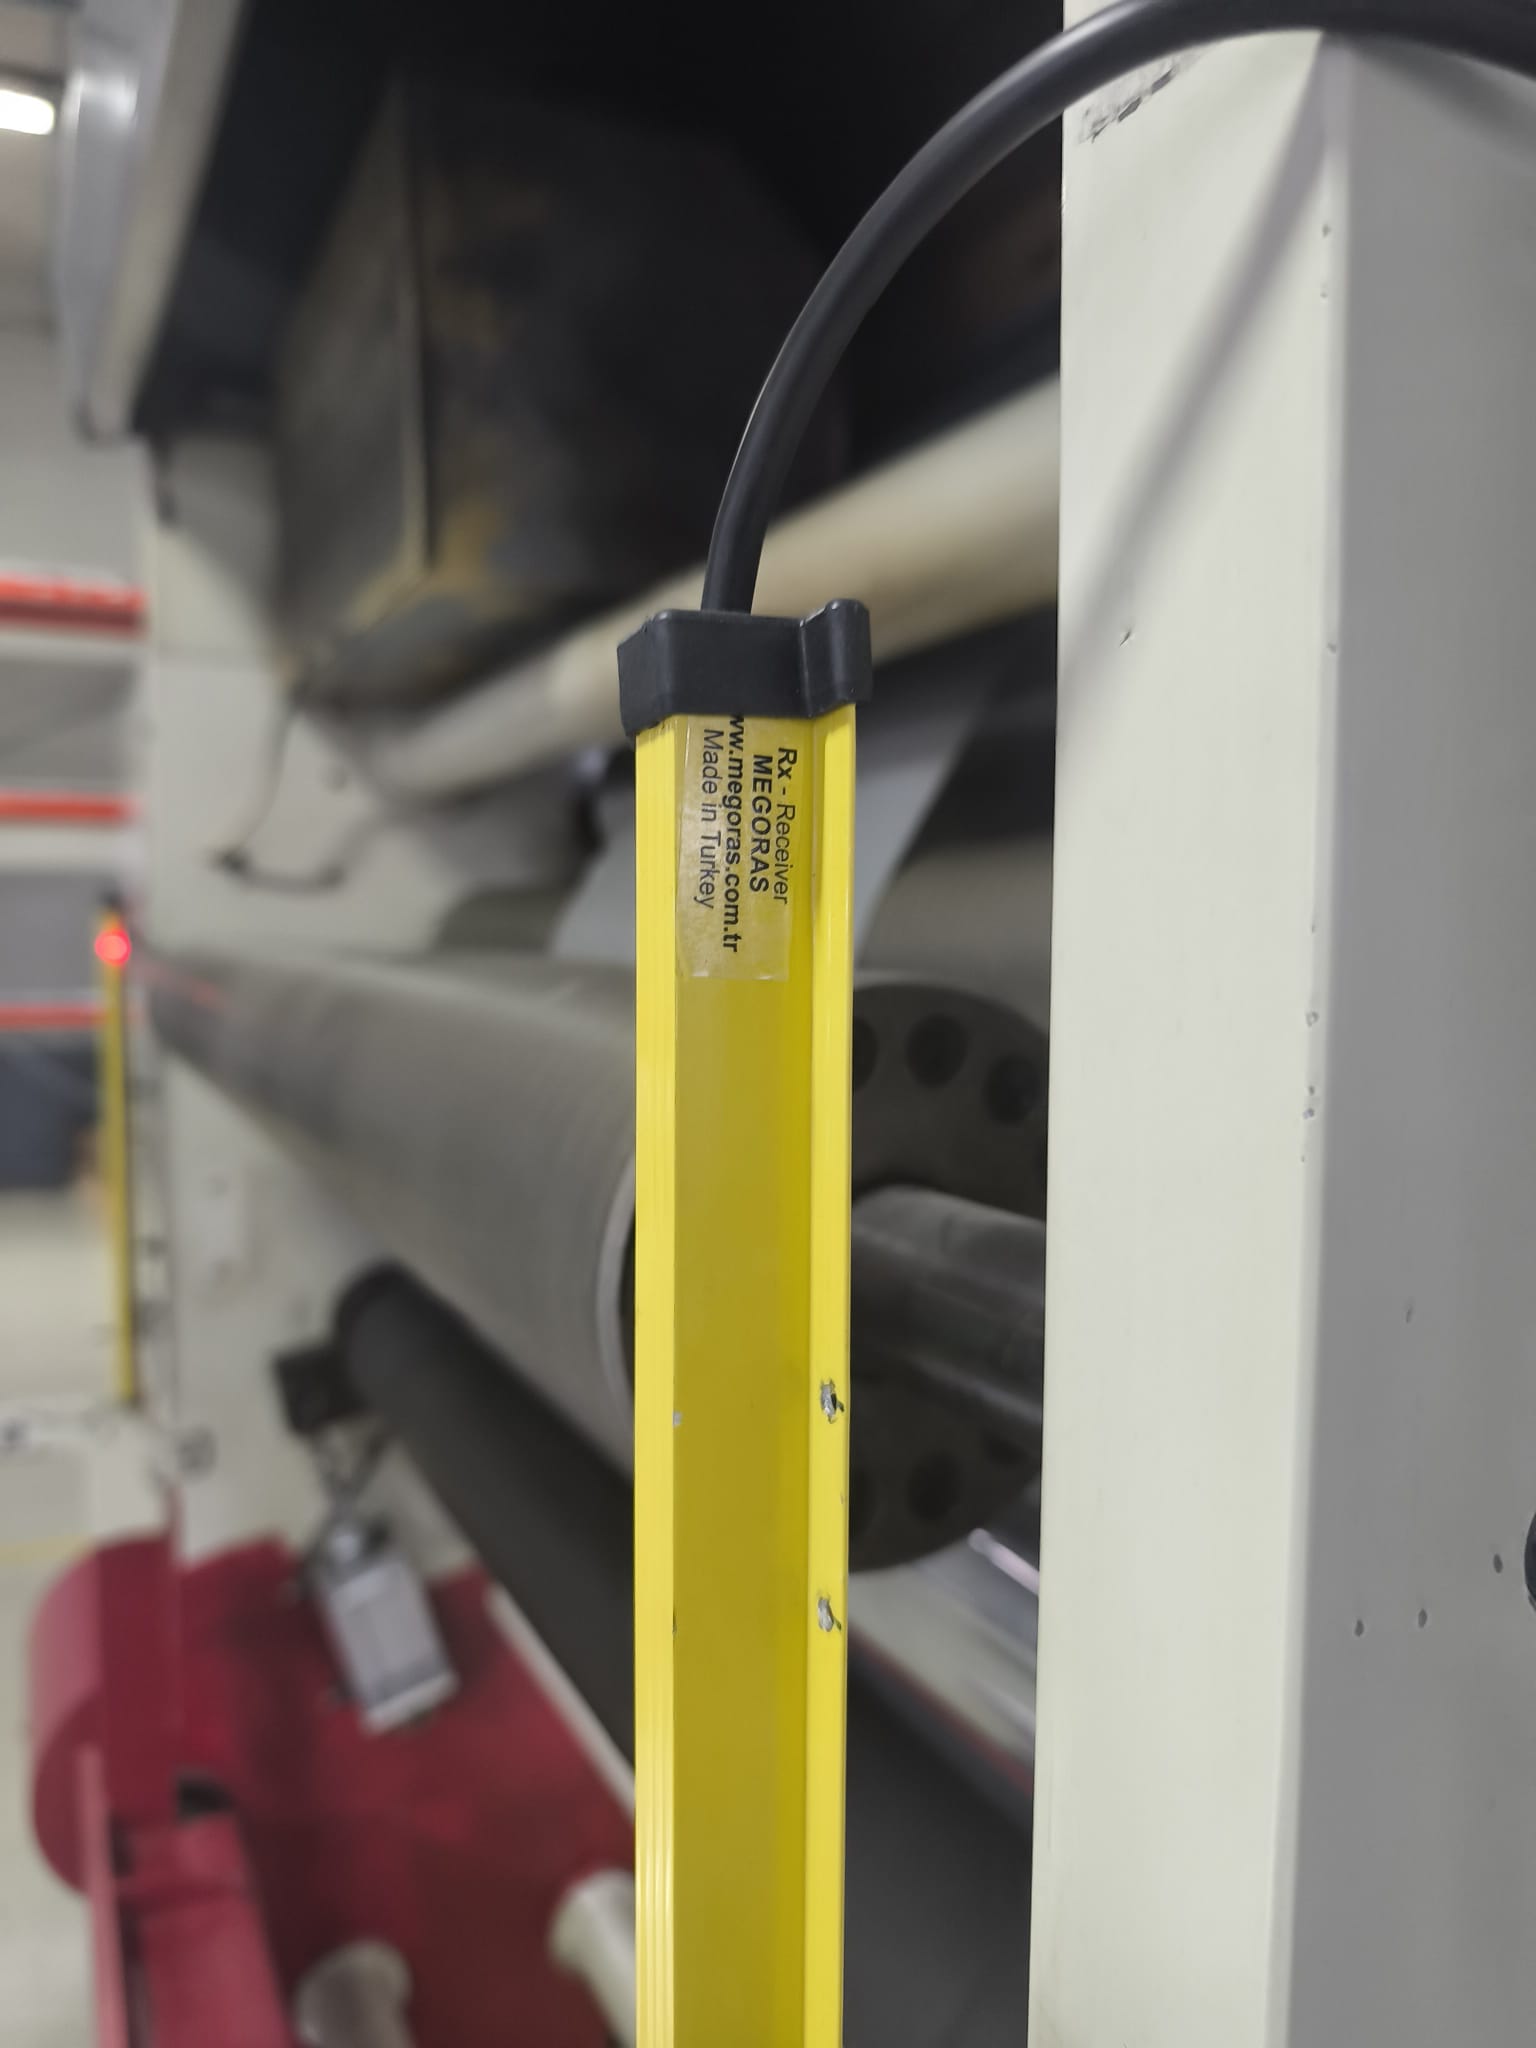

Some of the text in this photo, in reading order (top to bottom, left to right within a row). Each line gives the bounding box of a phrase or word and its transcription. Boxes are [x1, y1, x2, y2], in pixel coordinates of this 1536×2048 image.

[693, 728, 725, 910] Made in Turkey
[749, 754, 774, 893] MEGORAS
[777, 747, 798, 780] Rx
[773, 803, 796, 905] Receiver
